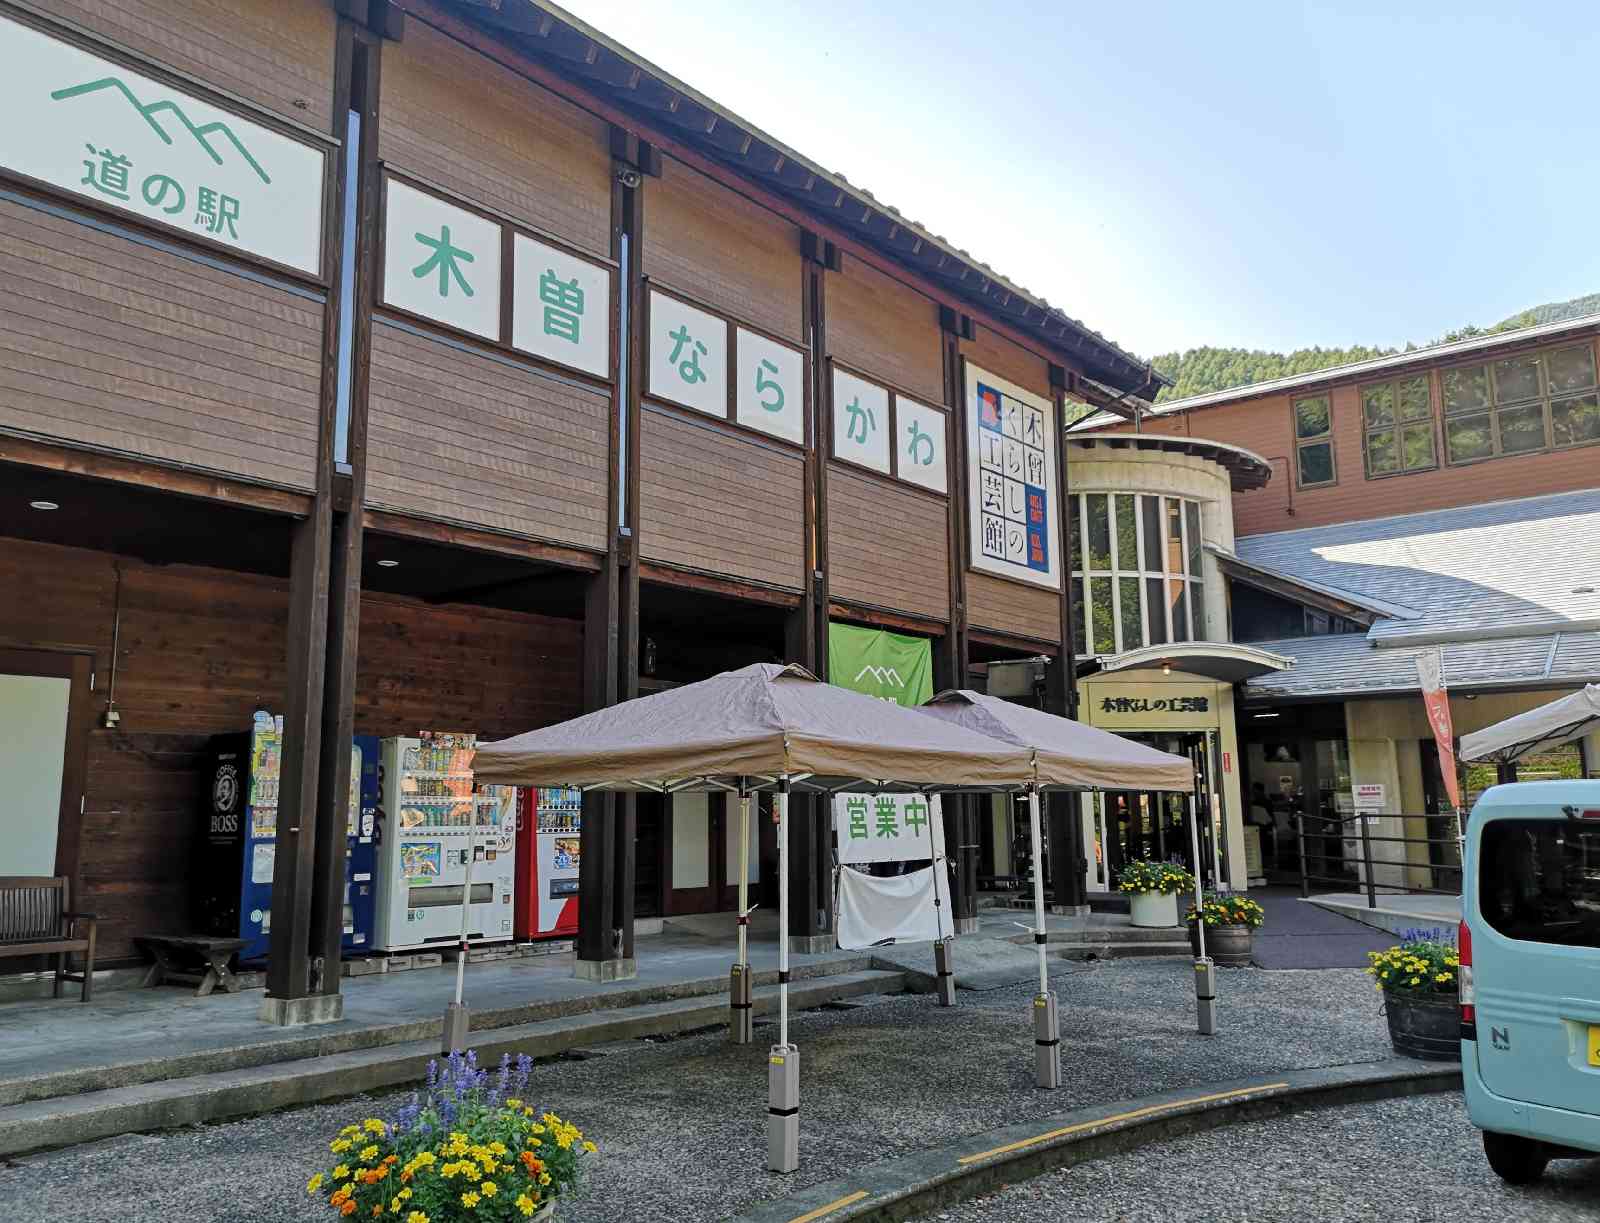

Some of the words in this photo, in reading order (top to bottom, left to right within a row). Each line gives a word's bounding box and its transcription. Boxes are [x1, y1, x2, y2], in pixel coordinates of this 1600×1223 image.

[81, 143, 241, 240] 道の駅
[983, 433, 1003, 554] 工芸館
[1007, 405, 1024, 554] くらしの
[210, 815, 239, 833] BOSS
[847, 797, 927, 839] 営業中
[1491, 1026, 1509, 1043] N
